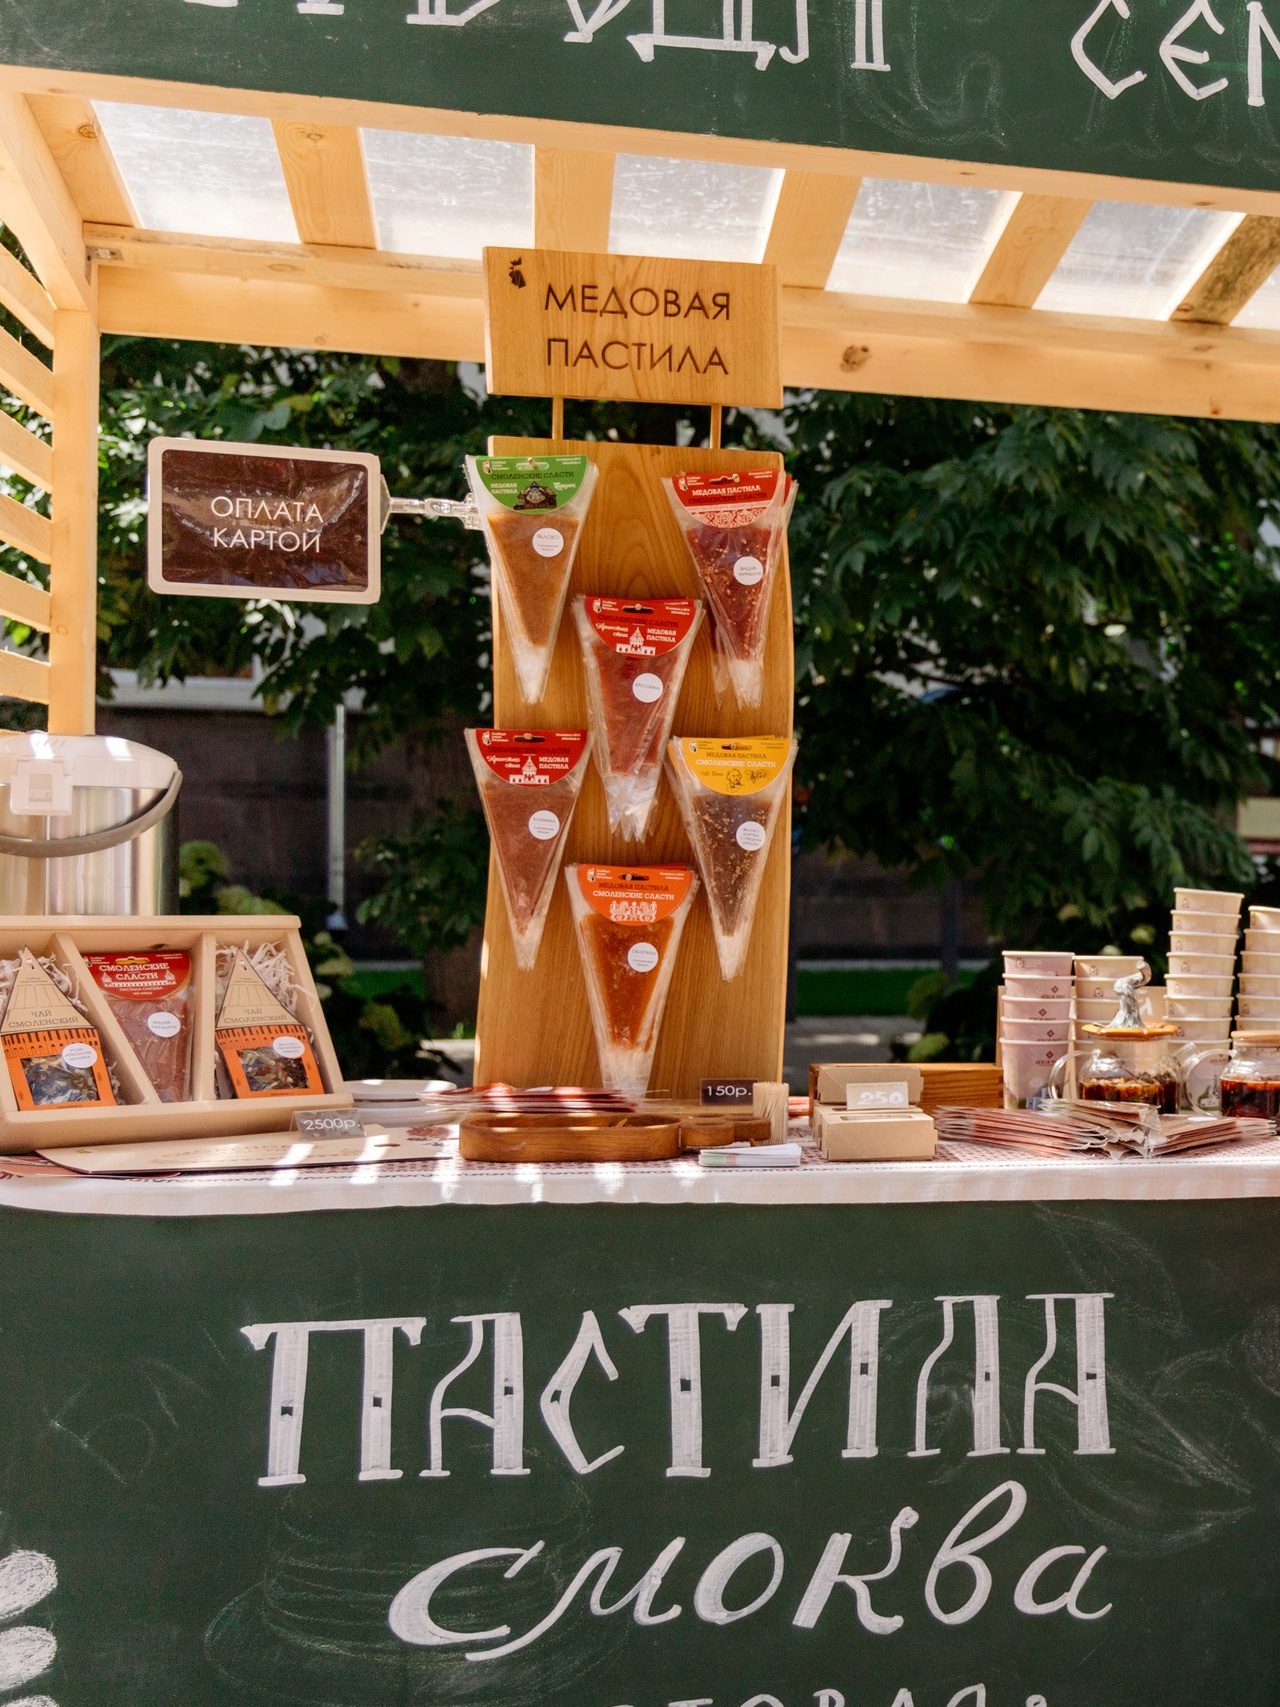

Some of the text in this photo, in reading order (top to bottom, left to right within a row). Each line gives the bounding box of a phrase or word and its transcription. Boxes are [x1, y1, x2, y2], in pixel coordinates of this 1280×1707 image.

[545, 283, 732, 321] МЕДОВАЯ
[546, 338, 730, 376] ПАСТИЛА
[491, 471, 574, 480] СМОЛЕНСКИЕ СЛАСТИ
[692, 485, 761, 496] МЕДОВАЯ ПАСТИЛА
[688, 493, 767, 504] СМОЛЕНСКИЕ СЛАСТИ
[211, 495, 324, 525] ОПЛАТА
[211, 522, 322, 554] КАРТОЙ
[598, 614, 679, 628] СМОЛЕНСКИЕ СЛАСТИ
[646, 628, 677, 636] МЕДОВАЯ
[646, 635, 676, 643] ПАСТИЛА
[696, 759, 745, 767] СМОЛЕНСКИЕ
[599, 882, 633, 890] МЕДОВАЯ
[593, 890, 675, 900] СМОЛЕНСКИЕ СЛАСТИ
[98, 963, 170, 972] СМОЛЕНСКИЕ
[115, 972, 159, 980] СЛАСТИ
[31, 1009, 53, 1018] ЧАЙ
[224, 1014, 287, 1024] СМОЛЕНСКИЙ
[8, 1016, 79, 1029] СМОЛЕНСКИЙ
[707, 1085, 752, 1098] 150р.
[857, 1091, 905, 1105] 250
[303, 1117, 361, 1130] 2500р.
[240, 1293, 1116, 1487] ПАСТИЛА
